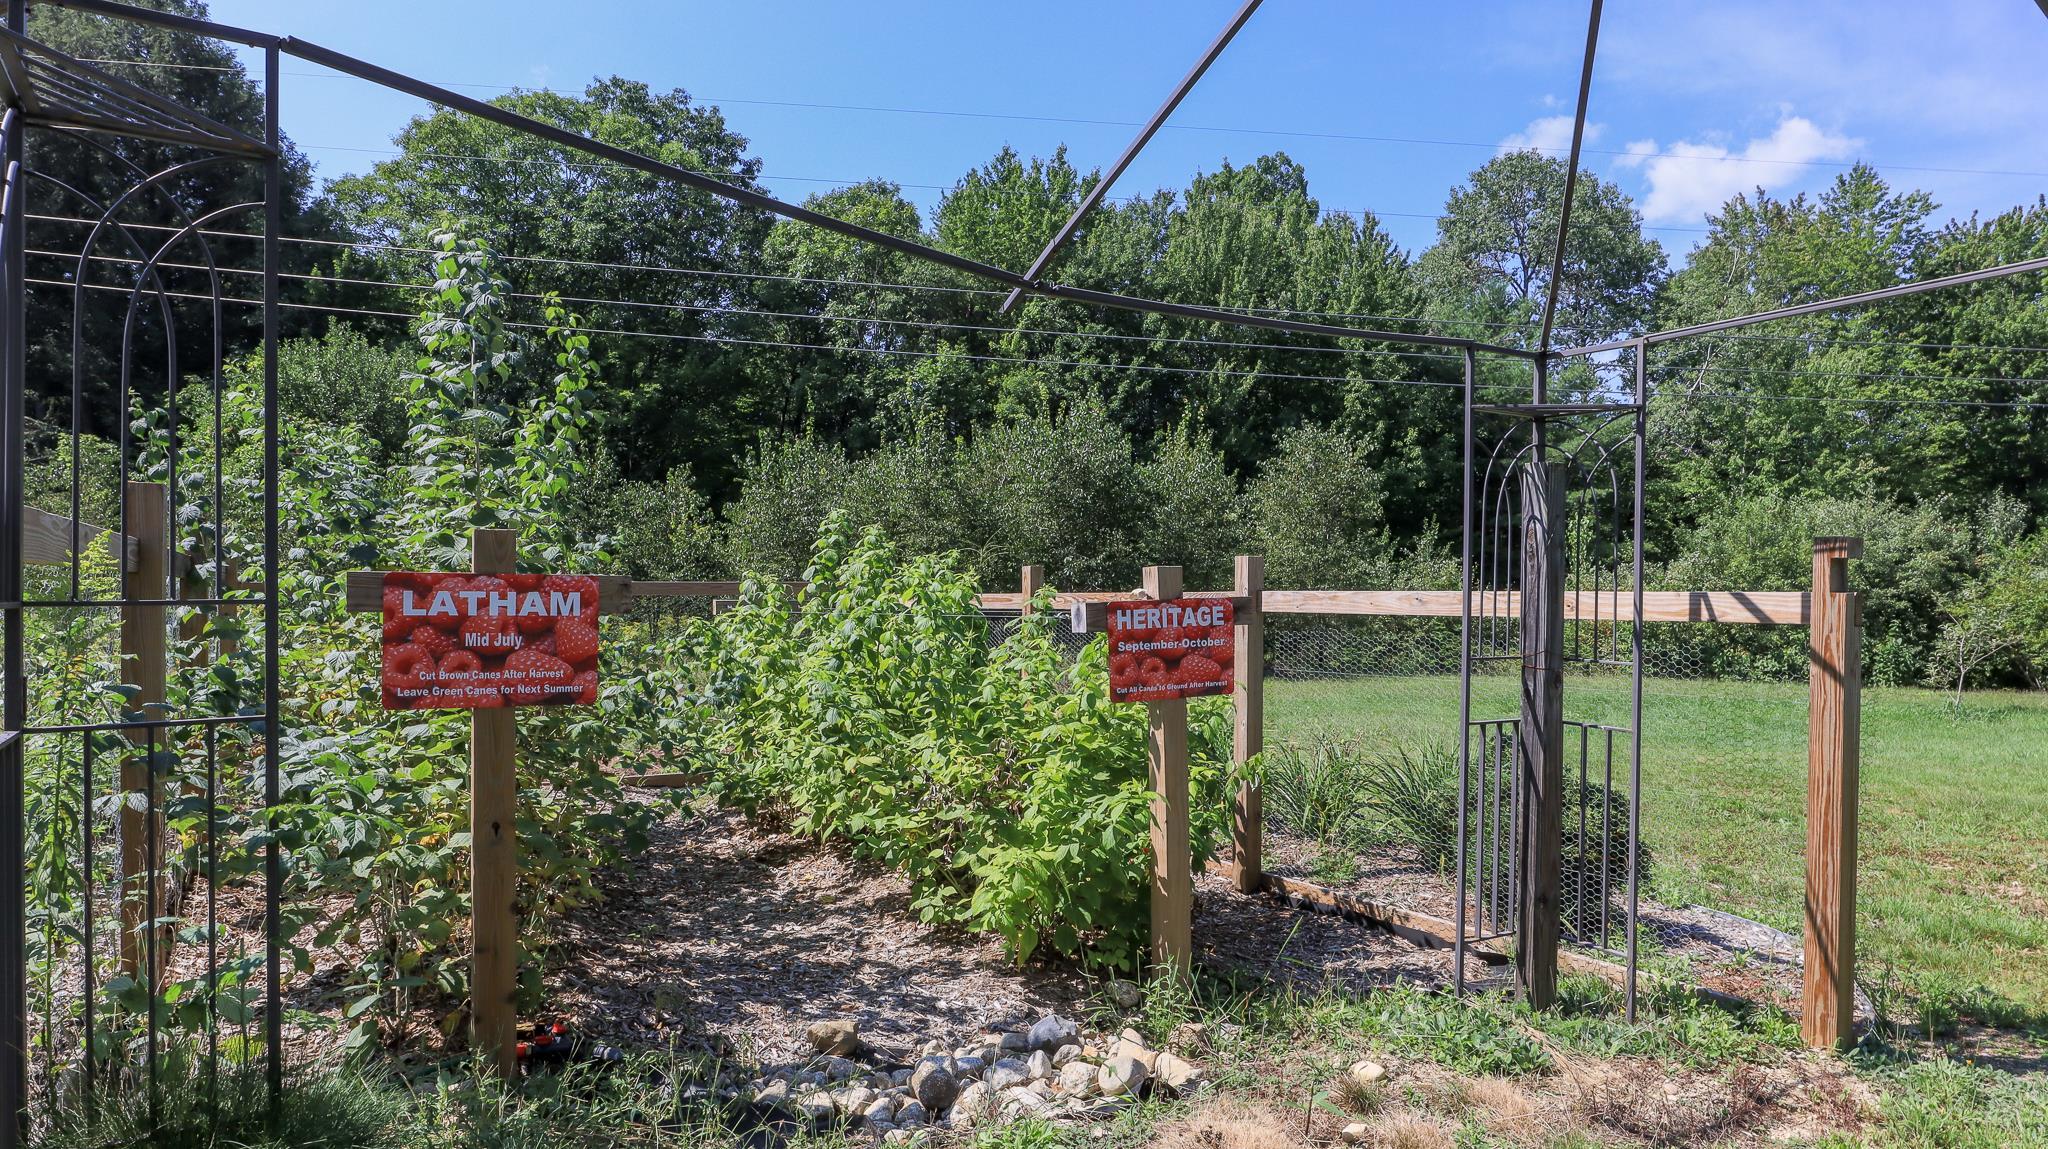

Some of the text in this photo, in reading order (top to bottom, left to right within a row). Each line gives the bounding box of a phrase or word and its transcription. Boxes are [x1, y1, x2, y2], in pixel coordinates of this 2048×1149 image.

[402, 590, 581, 617] LATHAM
[1116, 606, 1225, 630] HERITAGE
[465, 632, 523, 650] Mid July
[1117, 638, 1225, 653] September-October
[419, 668, 564, 681] Cut Brown Canes After Harvest
[397, 683, 584, 697] Leave Green Canes for Next Summer
[1205, 680, 1228, 688] Harvest
